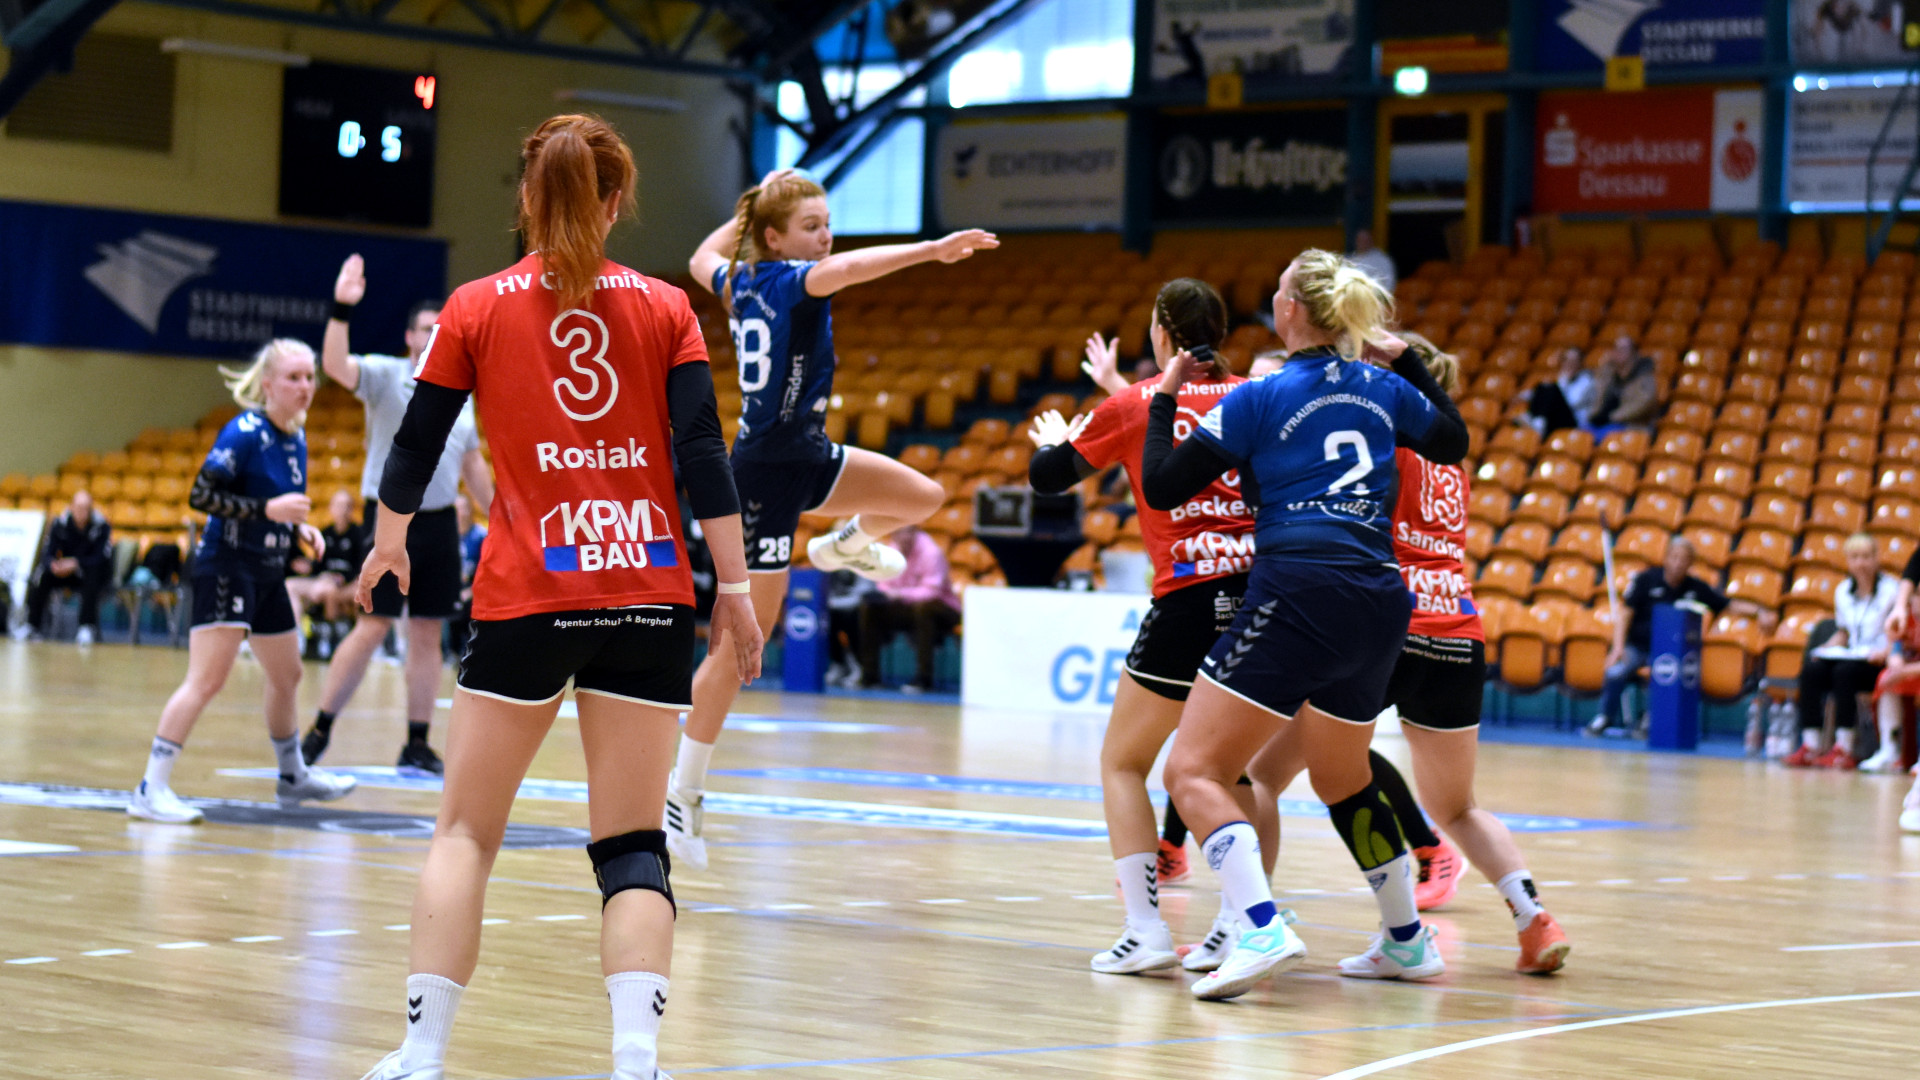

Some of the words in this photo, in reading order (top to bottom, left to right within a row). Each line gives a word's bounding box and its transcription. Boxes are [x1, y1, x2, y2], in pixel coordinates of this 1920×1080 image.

[1640, 42, 1715, 63] DESSAU
[415, 76, 436, 110] 4
[1579, 138, 1704, 168] Sparkasse
[1579, 169, 1669, 198] Dessau
[496, 273, 532, 295] HV
[550, 309, 619, 421] 3
[536, 438, 648, 472] Rosiak
[1323, 430, 1375, 496] 2
[288, 457, 303, 485] 3
[1416, 453, 1465, 532] 13
[560, 499, 654, 545] KPM
[579, 543, 648, 572] BAU
[758, 535, 791, 562] 28
[1185, 531, 1257, 562] KPM
[1197, 556, 1253, 576] BAU
[1214, 612, 1236, 620] Sach
[1417, 592, 1460, 615] BAU
[554, 619, 593, 629] Agentur
[594, 617, 624, 627] Schul
[635, 616, 674, 627] Berghoff
